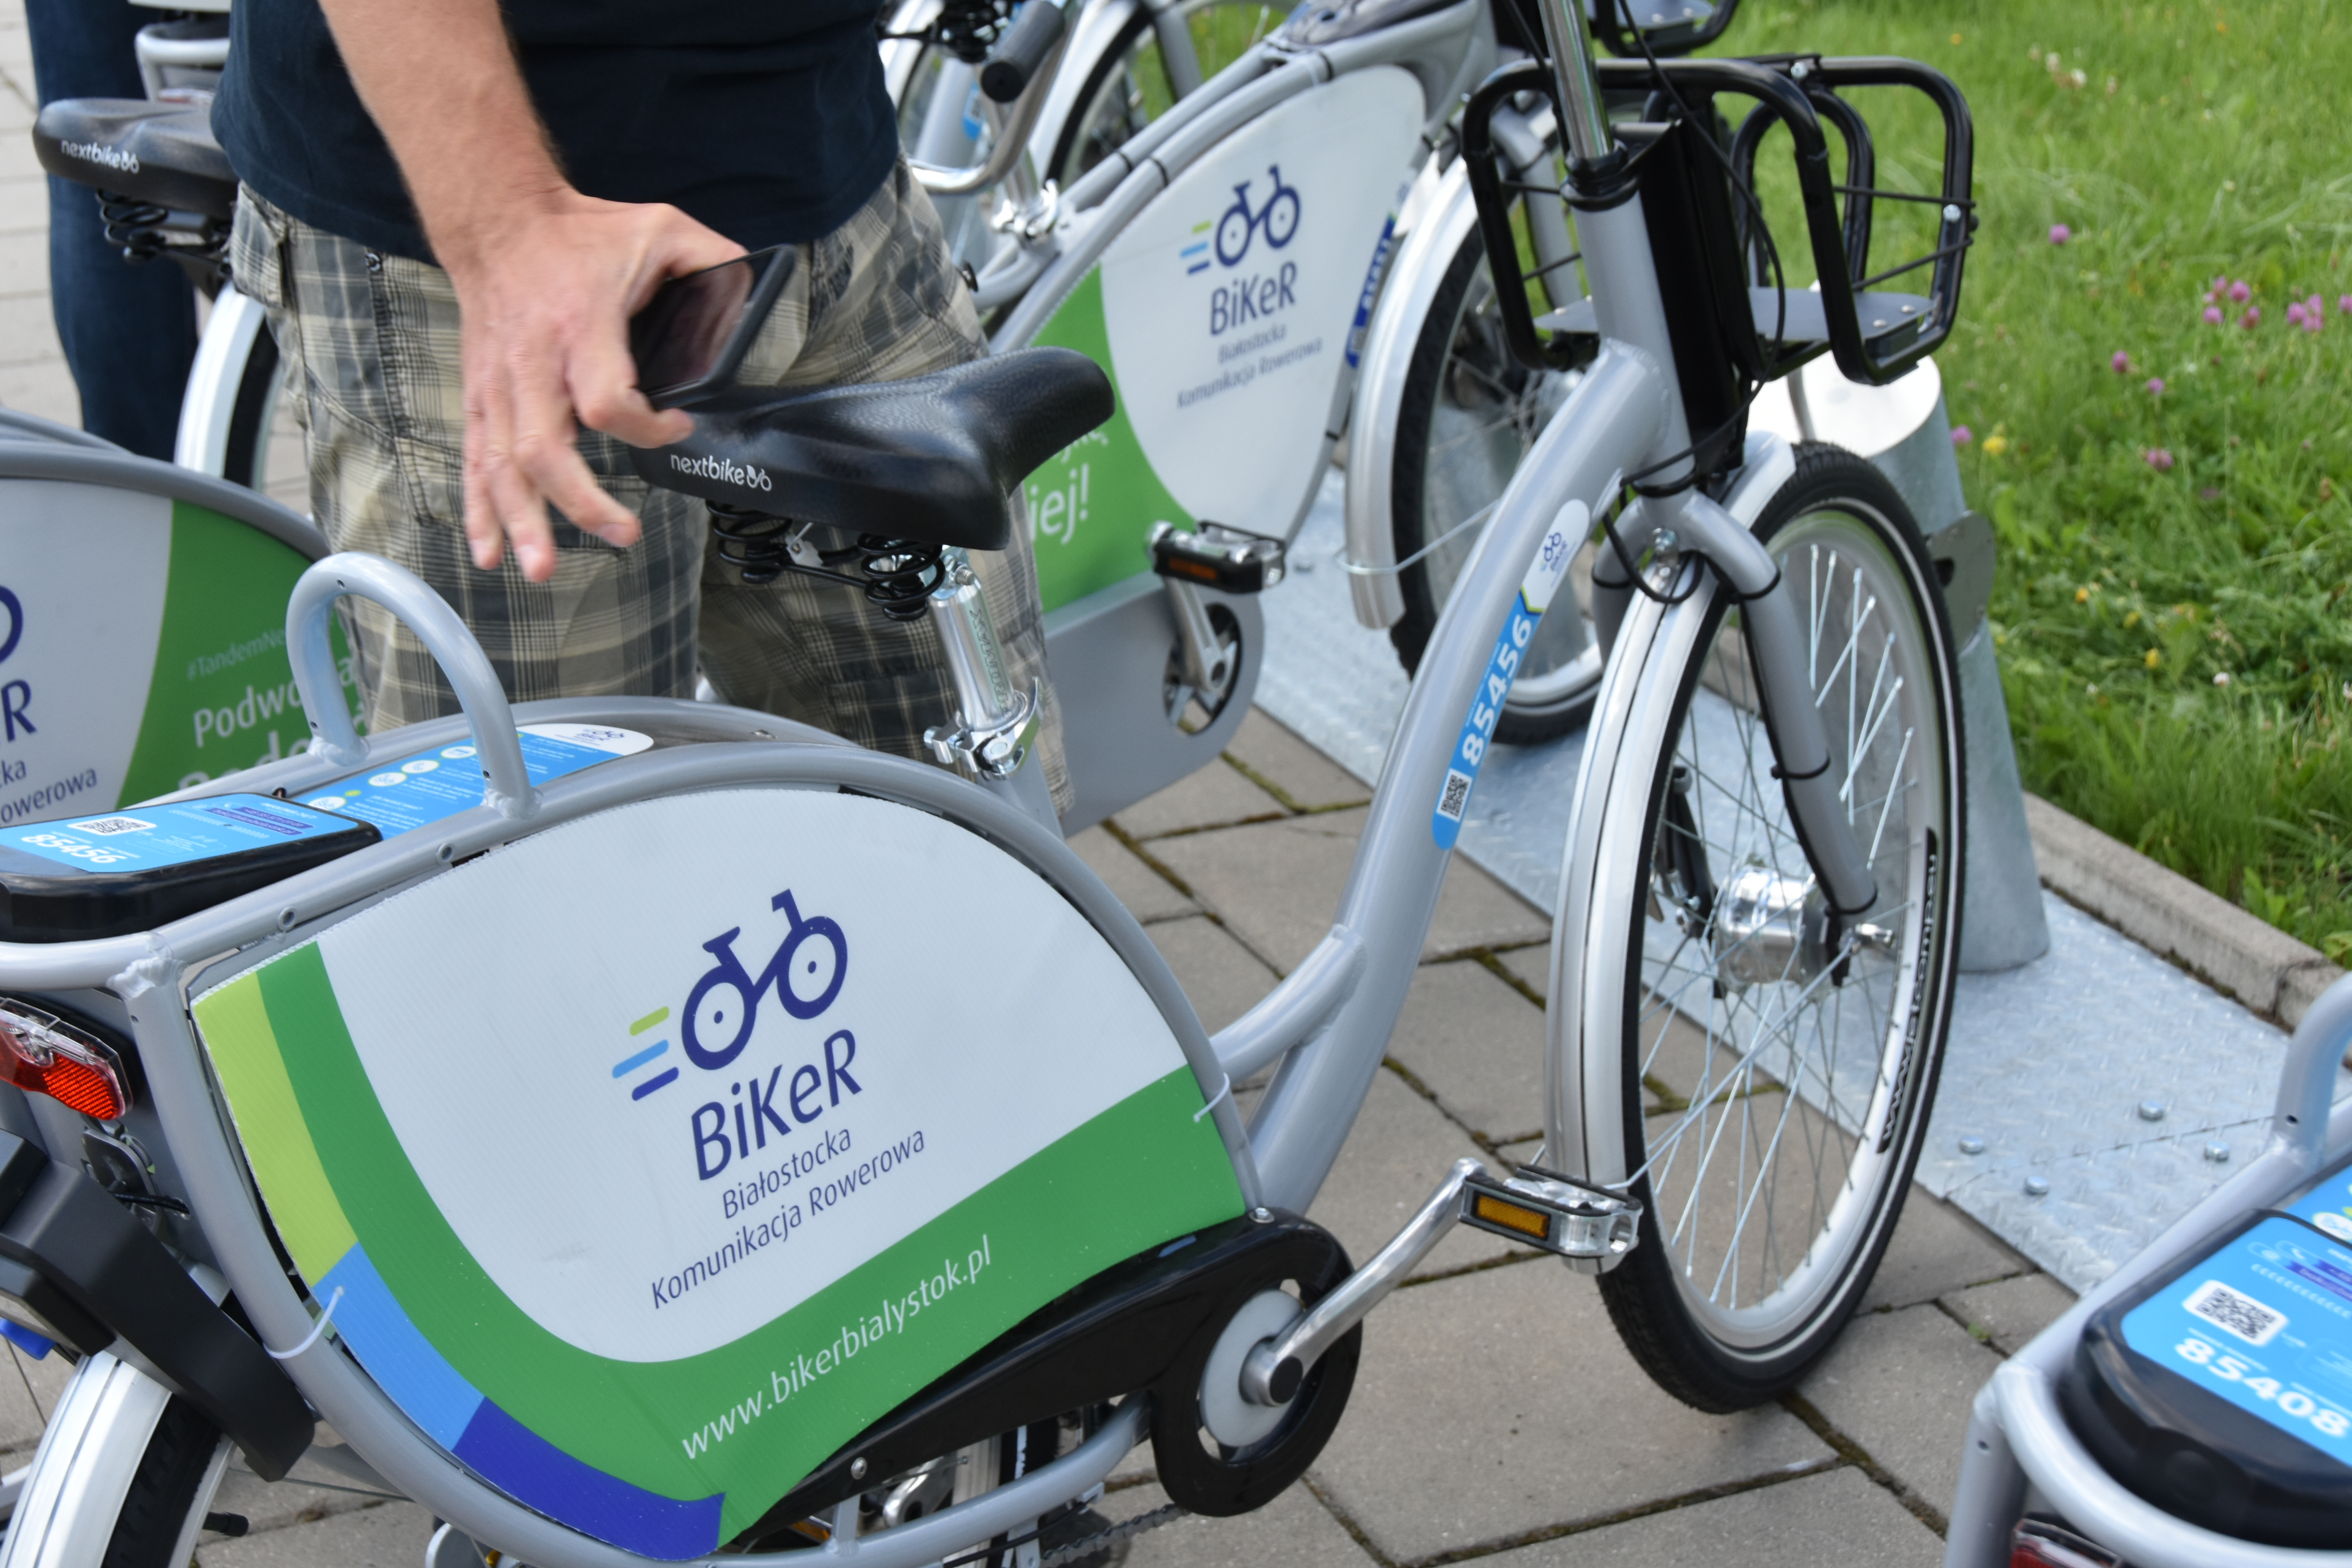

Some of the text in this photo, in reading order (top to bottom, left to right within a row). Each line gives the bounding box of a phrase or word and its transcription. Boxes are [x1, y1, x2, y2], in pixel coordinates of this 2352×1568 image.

[61, 140, 121, 169] nextbike
[1210, 260, 1297, 336] BiKeR
[670, 454, 745, 486] nextbike
[969, 609, 1012, 718] PROMAX
[1462, 614, 1532, 767] 85456
[1, 768, 97, 823] owerowa
[21, 834, 128, 863] 85456
[691, 1029, 862, 1180] BiKeR
[652, 1131, 925, 1309] Komunikacja Rowerowa
[722, 1129, 851, 1219] Białostocka
[682, 1234, 991, 1459] www.bikerbialystok.pl
[2175, 1338, 2351, 1438] 85408
